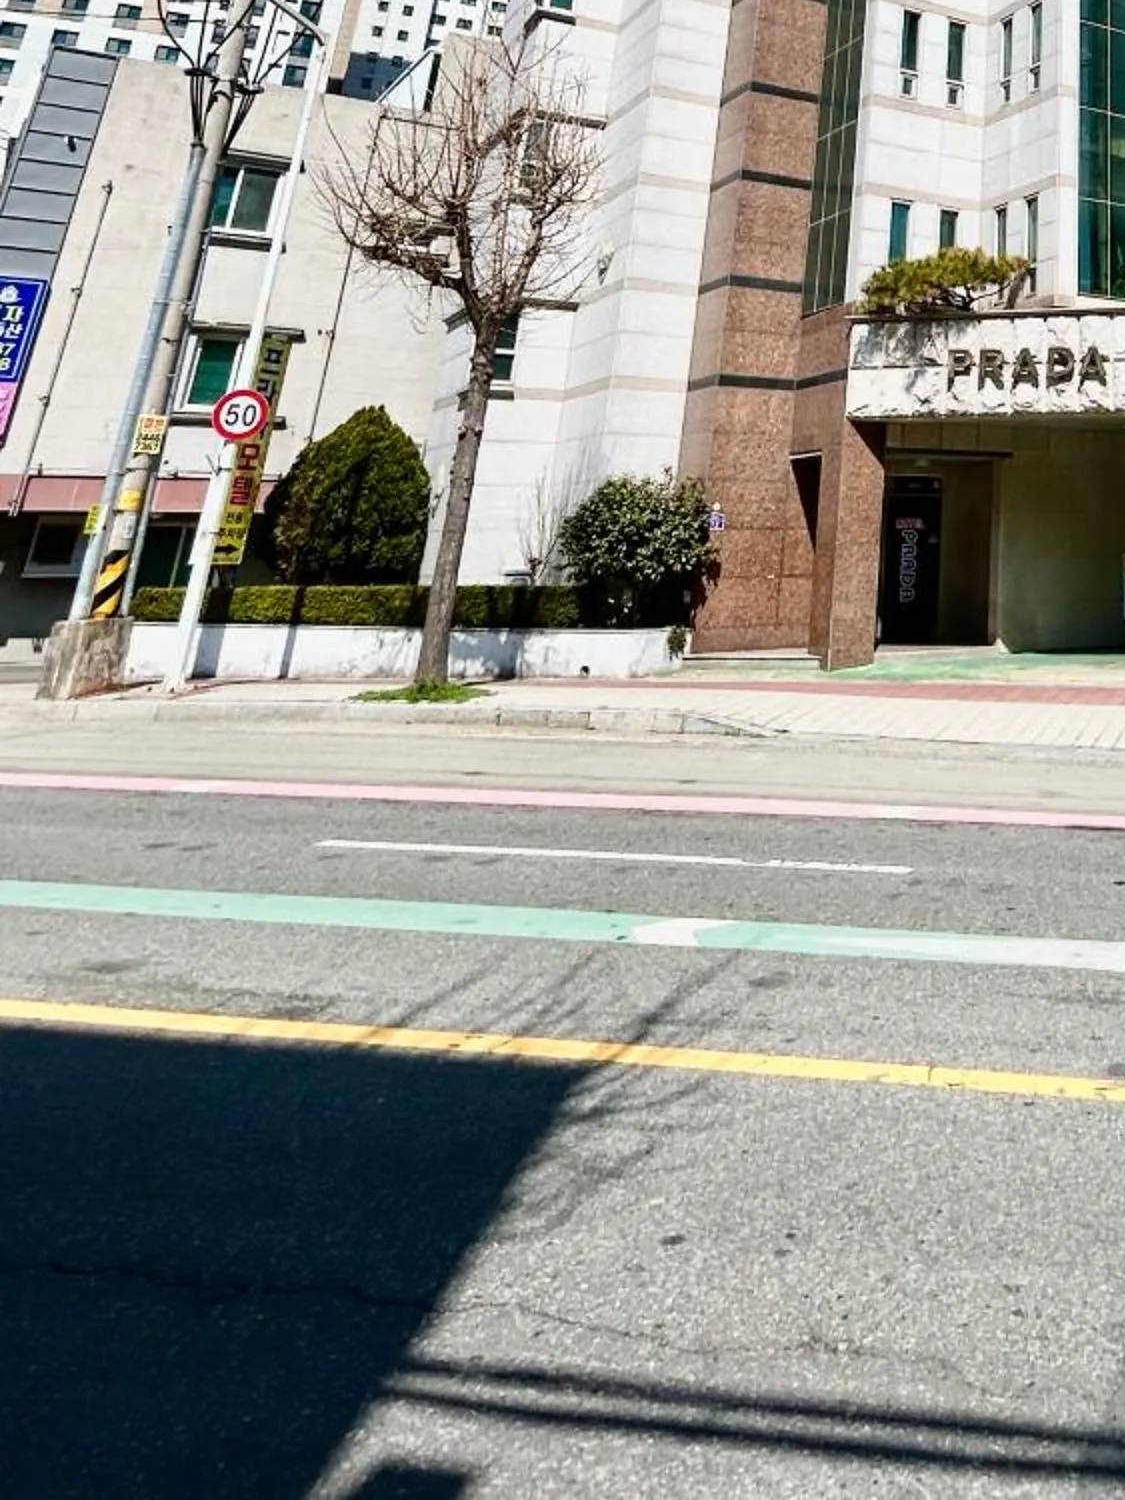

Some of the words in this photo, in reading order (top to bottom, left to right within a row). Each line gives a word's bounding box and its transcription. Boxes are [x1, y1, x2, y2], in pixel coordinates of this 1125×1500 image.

[947, 346, 1108, 392] PRADA
[224, 403, 257, 427] 50
[230, 443, 260, 506] 모텔
